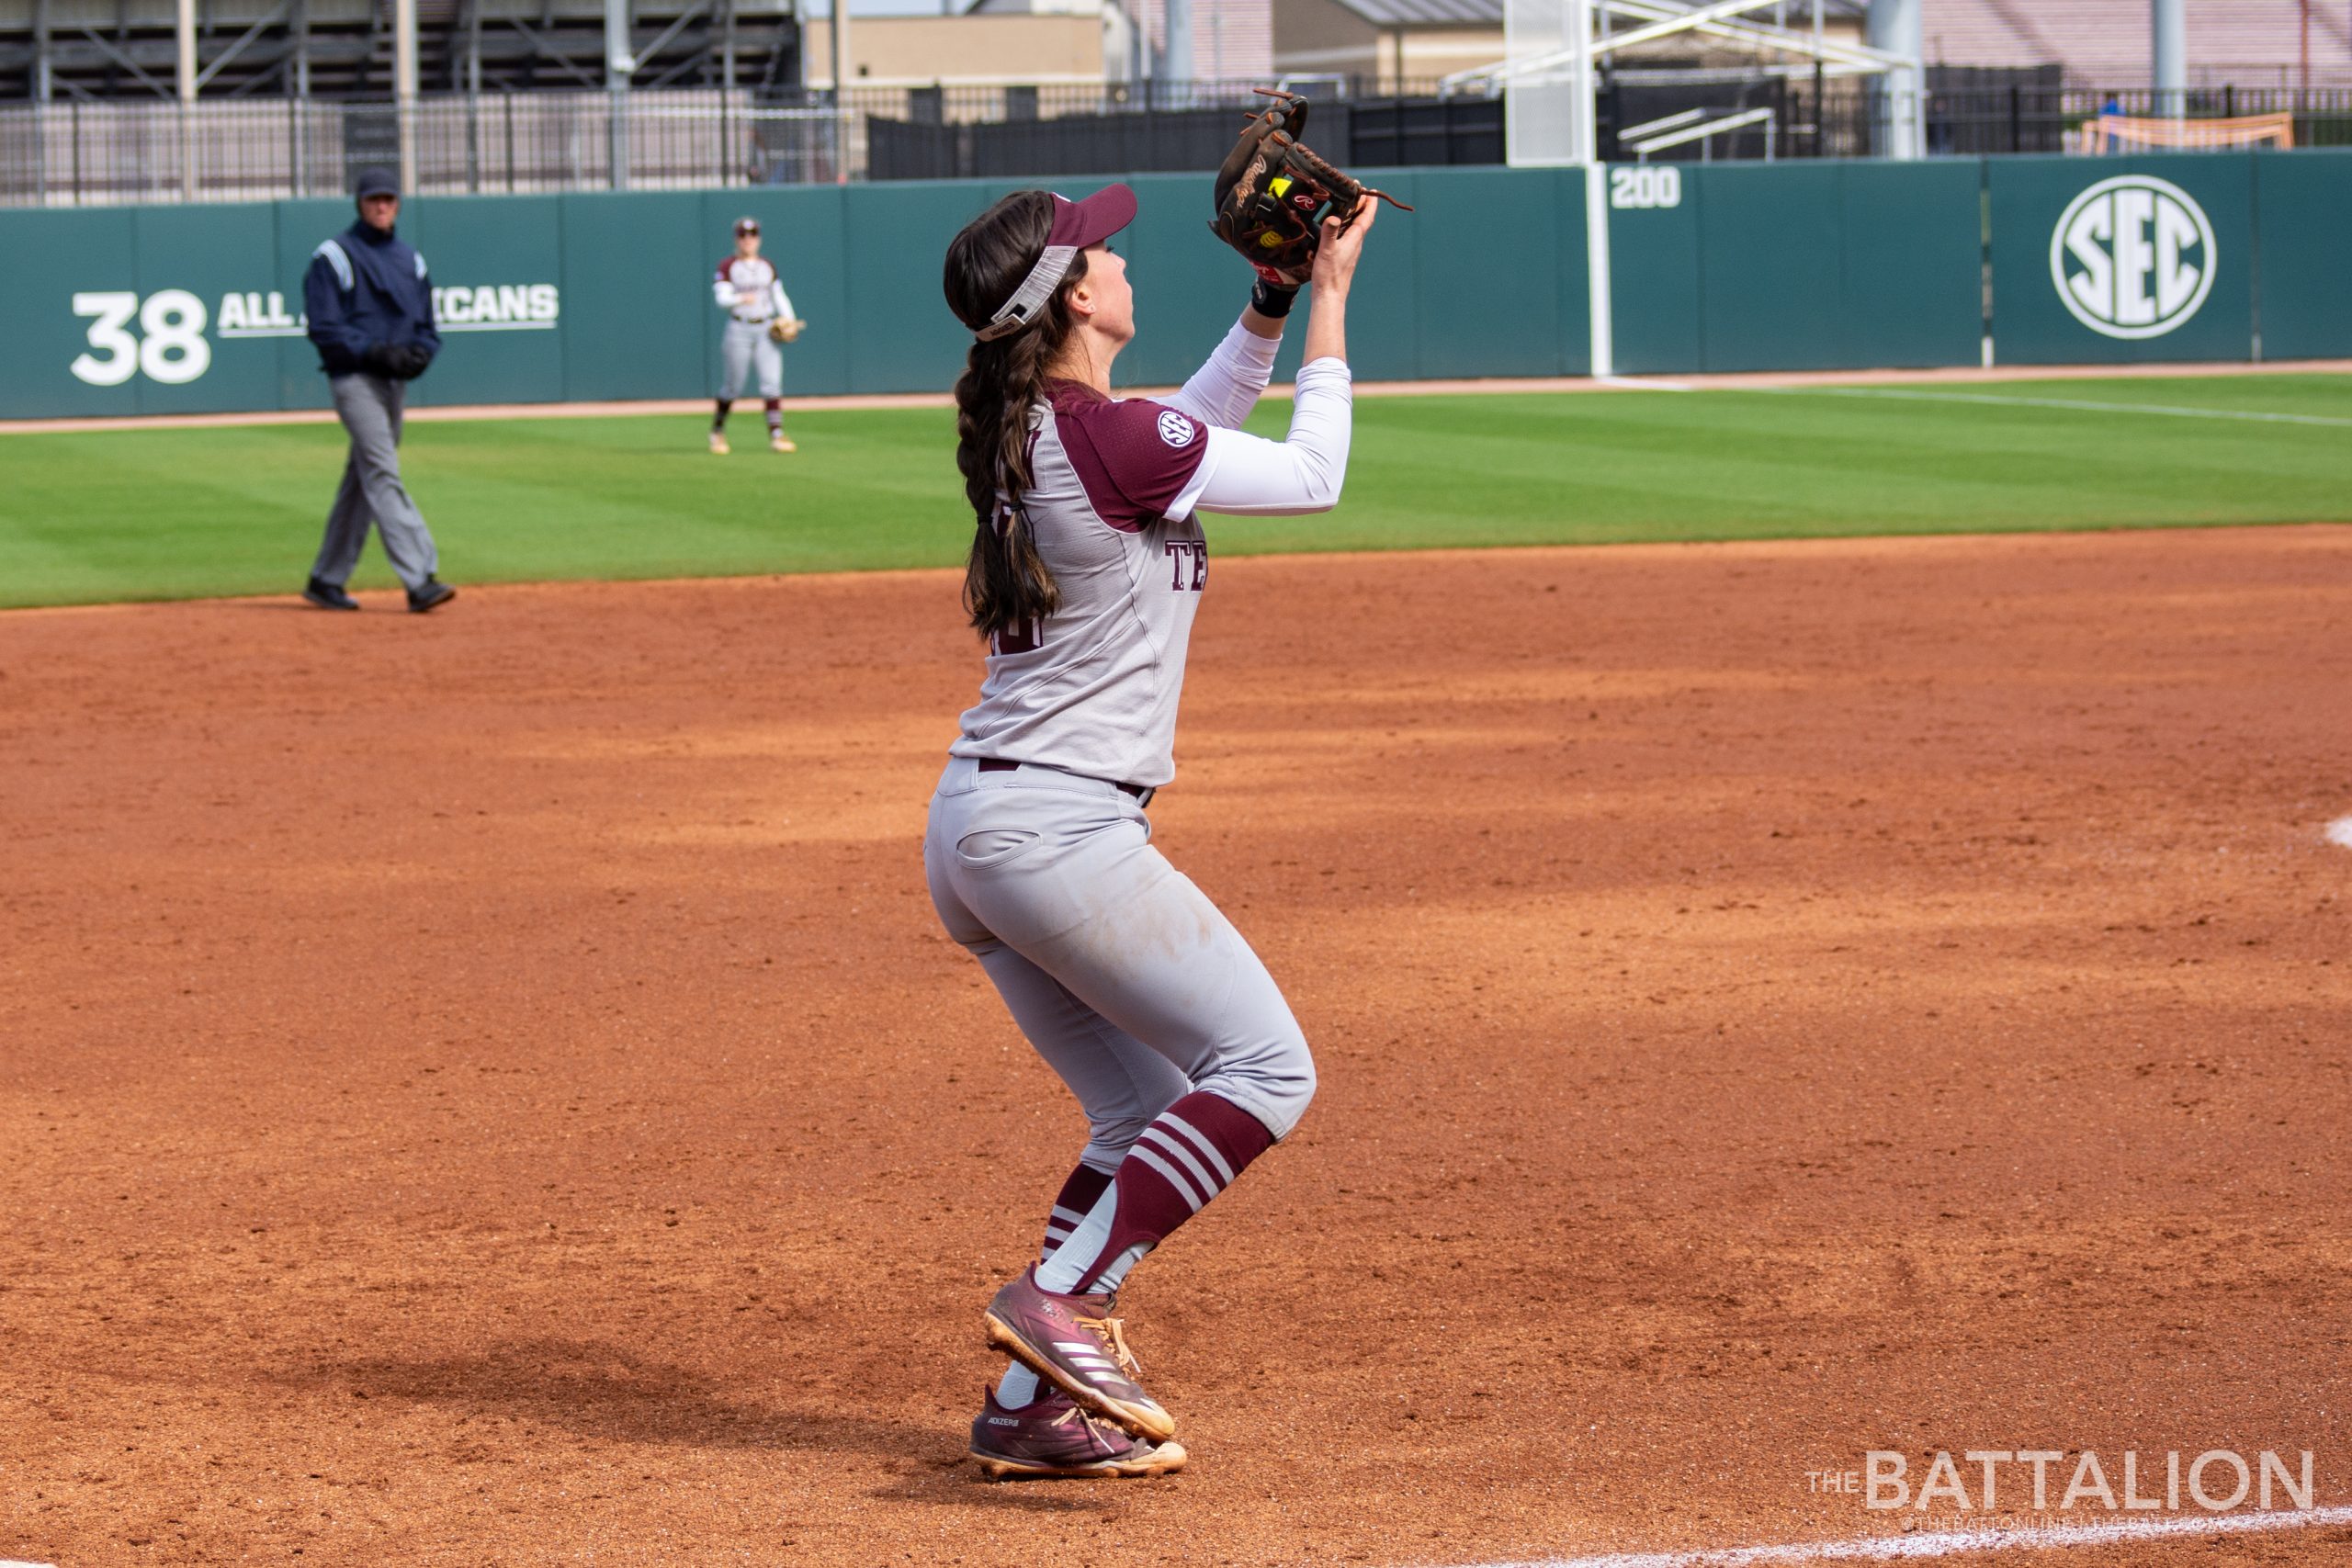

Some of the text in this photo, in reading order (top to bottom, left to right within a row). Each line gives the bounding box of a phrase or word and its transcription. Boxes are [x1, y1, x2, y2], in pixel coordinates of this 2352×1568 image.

[1611, 166, 1681, 209] 200
[2066, 189, 2199, 321] SEC
[71, 289, 210, 386] 38
[218, 284, 559, 328] ALL ICANS
